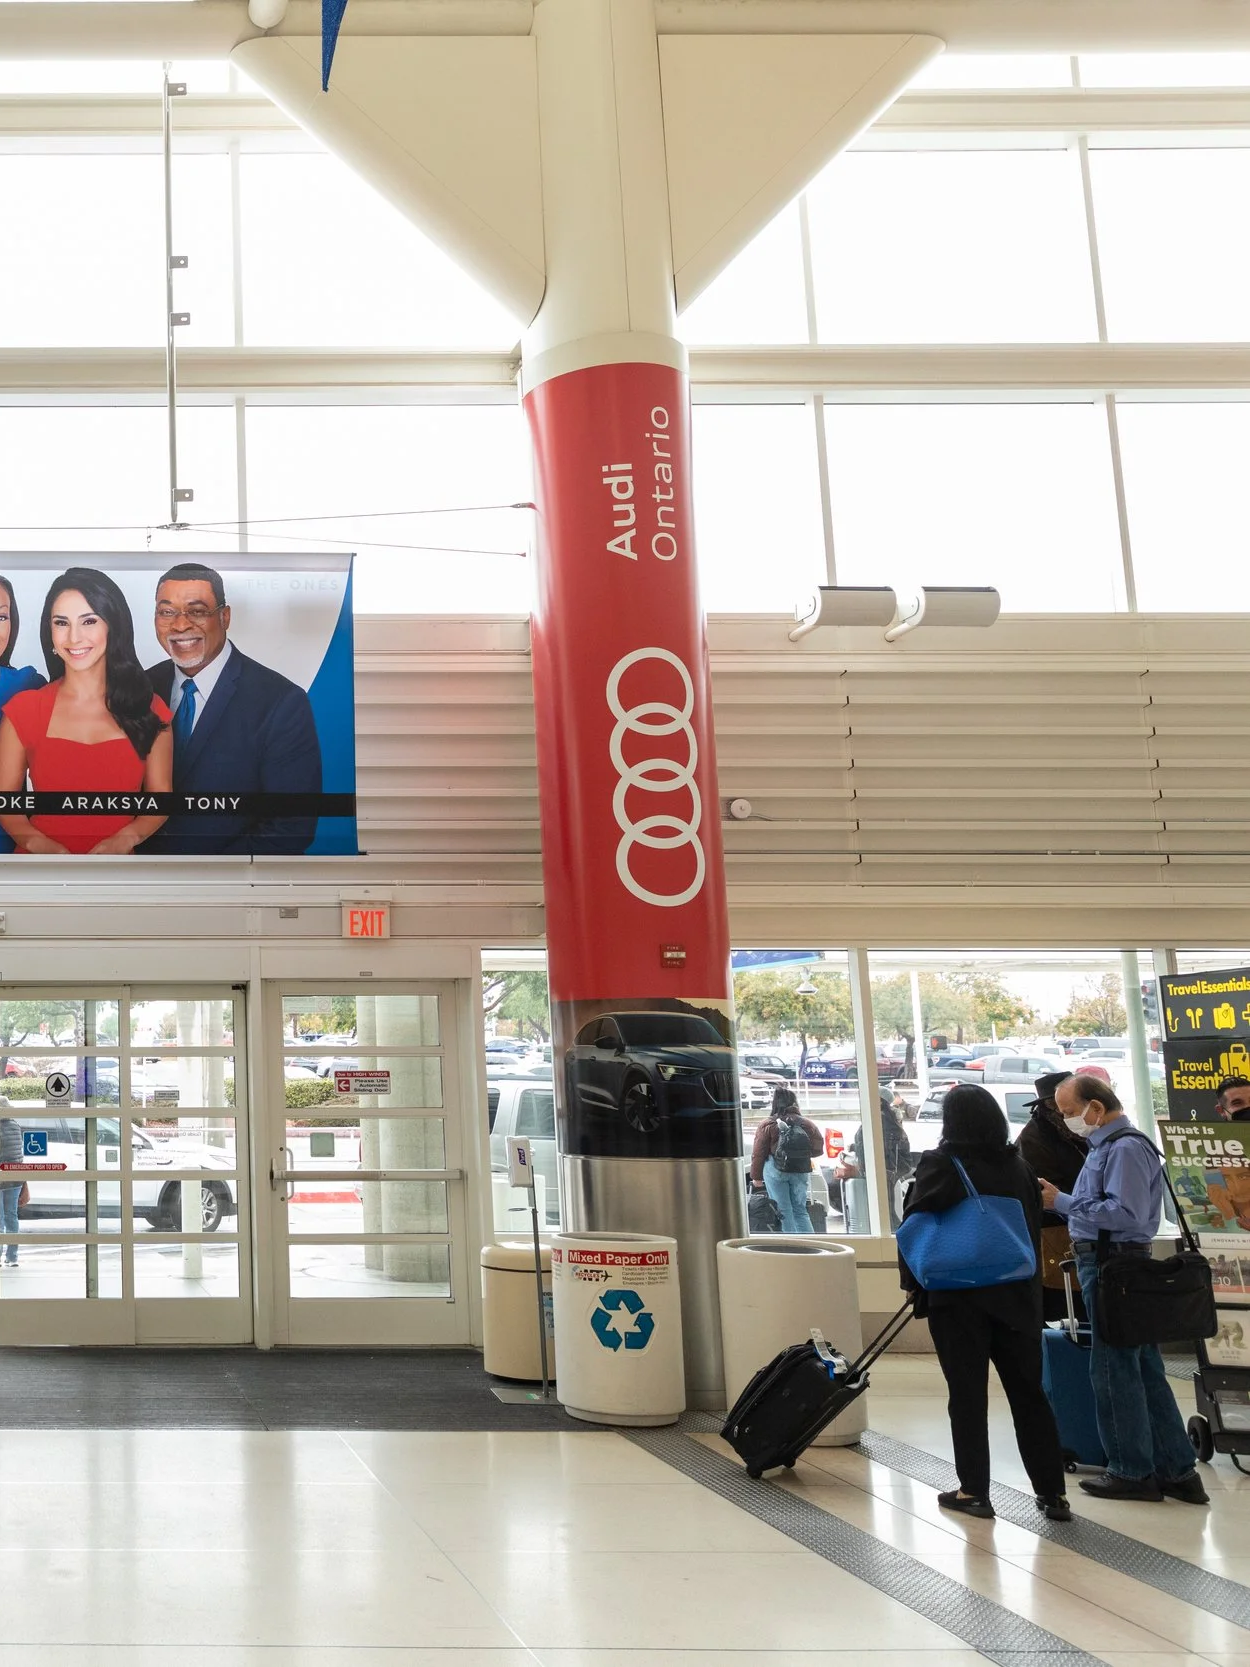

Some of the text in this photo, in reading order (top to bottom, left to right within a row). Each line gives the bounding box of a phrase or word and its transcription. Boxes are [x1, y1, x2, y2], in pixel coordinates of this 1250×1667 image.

[645, 406, 678, 561] Ontario
[602, 463, 638, 561] Audi
[62, 795, 159, 810] ARAKSYA
[185, 796, 241, 810] TONY
[349, 910, 385, 937] EXIT
[1178, 1058, 1213, 1072] Travel
[1164, 1125, 1215, 1135] What Is
[1166, 1135, 1244, 1155] True
[1171, 1156, 1250, 1168] SUCCESS?
[569, 1251, 668, 1266] Mixed Paper Only
